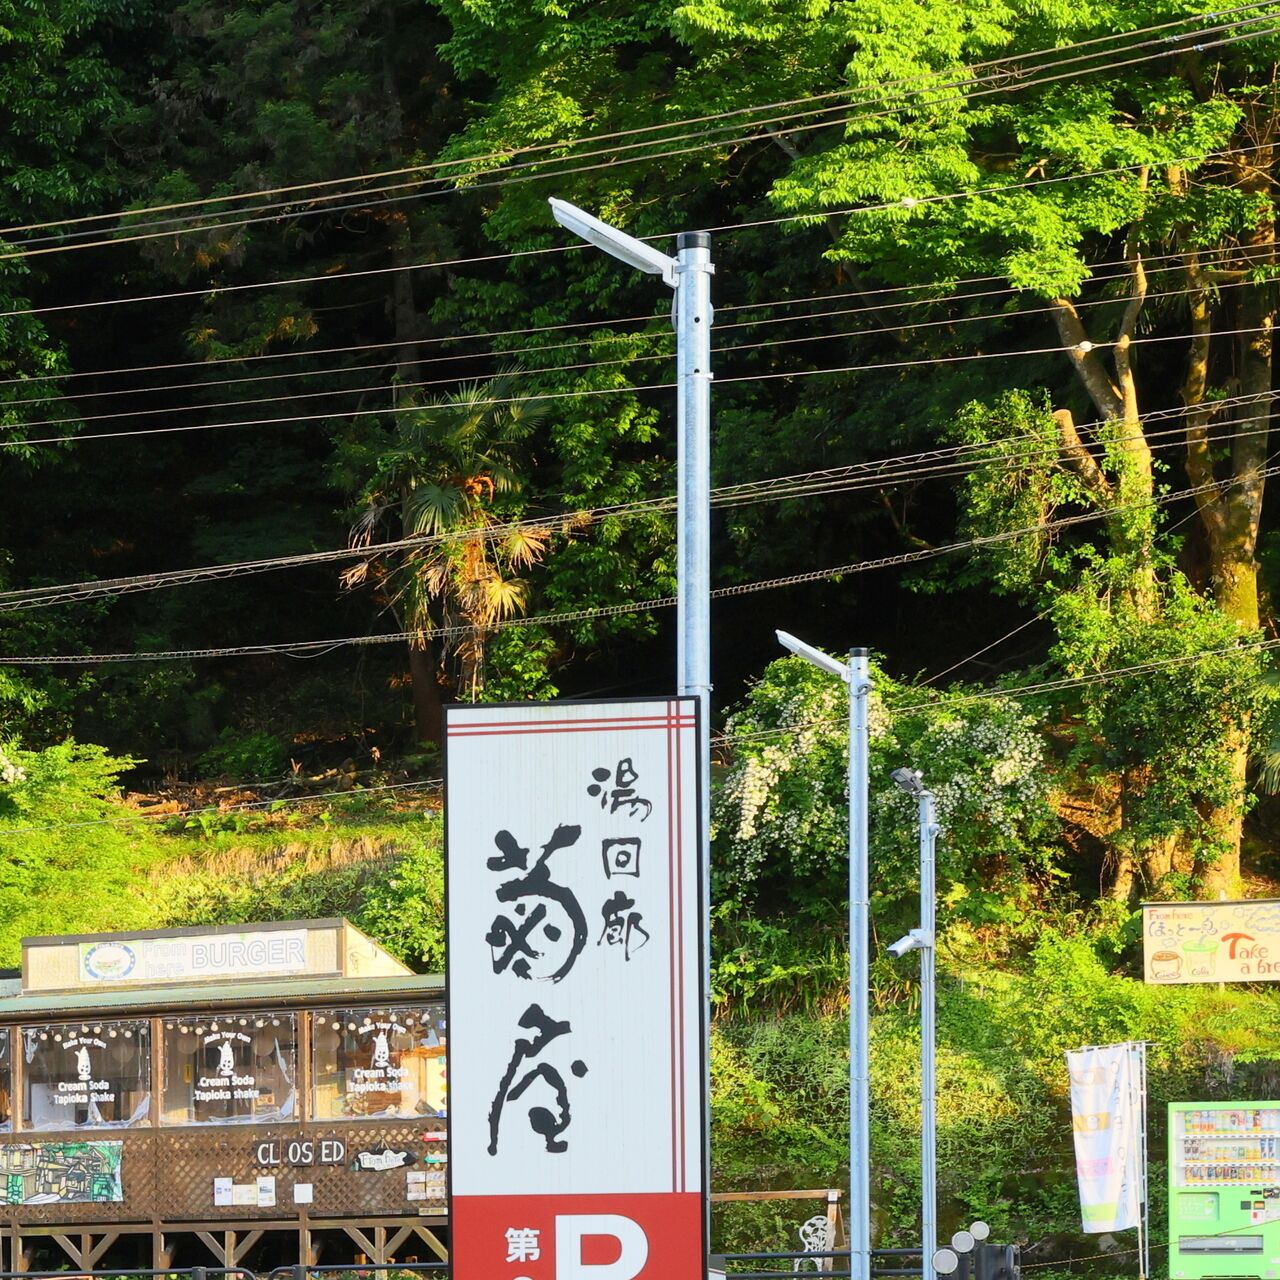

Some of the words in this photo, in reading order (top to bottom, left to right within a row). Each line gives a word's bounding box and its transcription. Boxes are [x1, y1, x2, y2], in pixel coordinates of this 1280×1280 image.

[587, 757, 651, 962] 湯回廊
[1221, 932, 1268, 959] Take
[191, 938, 305, 969] BURGER
[485, 824, 589, 1156] 菊屋
[354, 1068, 384, 1078] Cream
[387, 1067, 409, 1077] Soda
[58, 1082, 88, 1091] Cream
[88, 1080, 110, 1090] Soda
[199, 1076, 229, 1087] Cream
[231, 1074, 255, 1086] Soda
[349, 1081, 386, 1093] Tapioka
[54, 1094, 89, 1106] Tapioka
[194, 1090, 231, 1103] Tapioka
